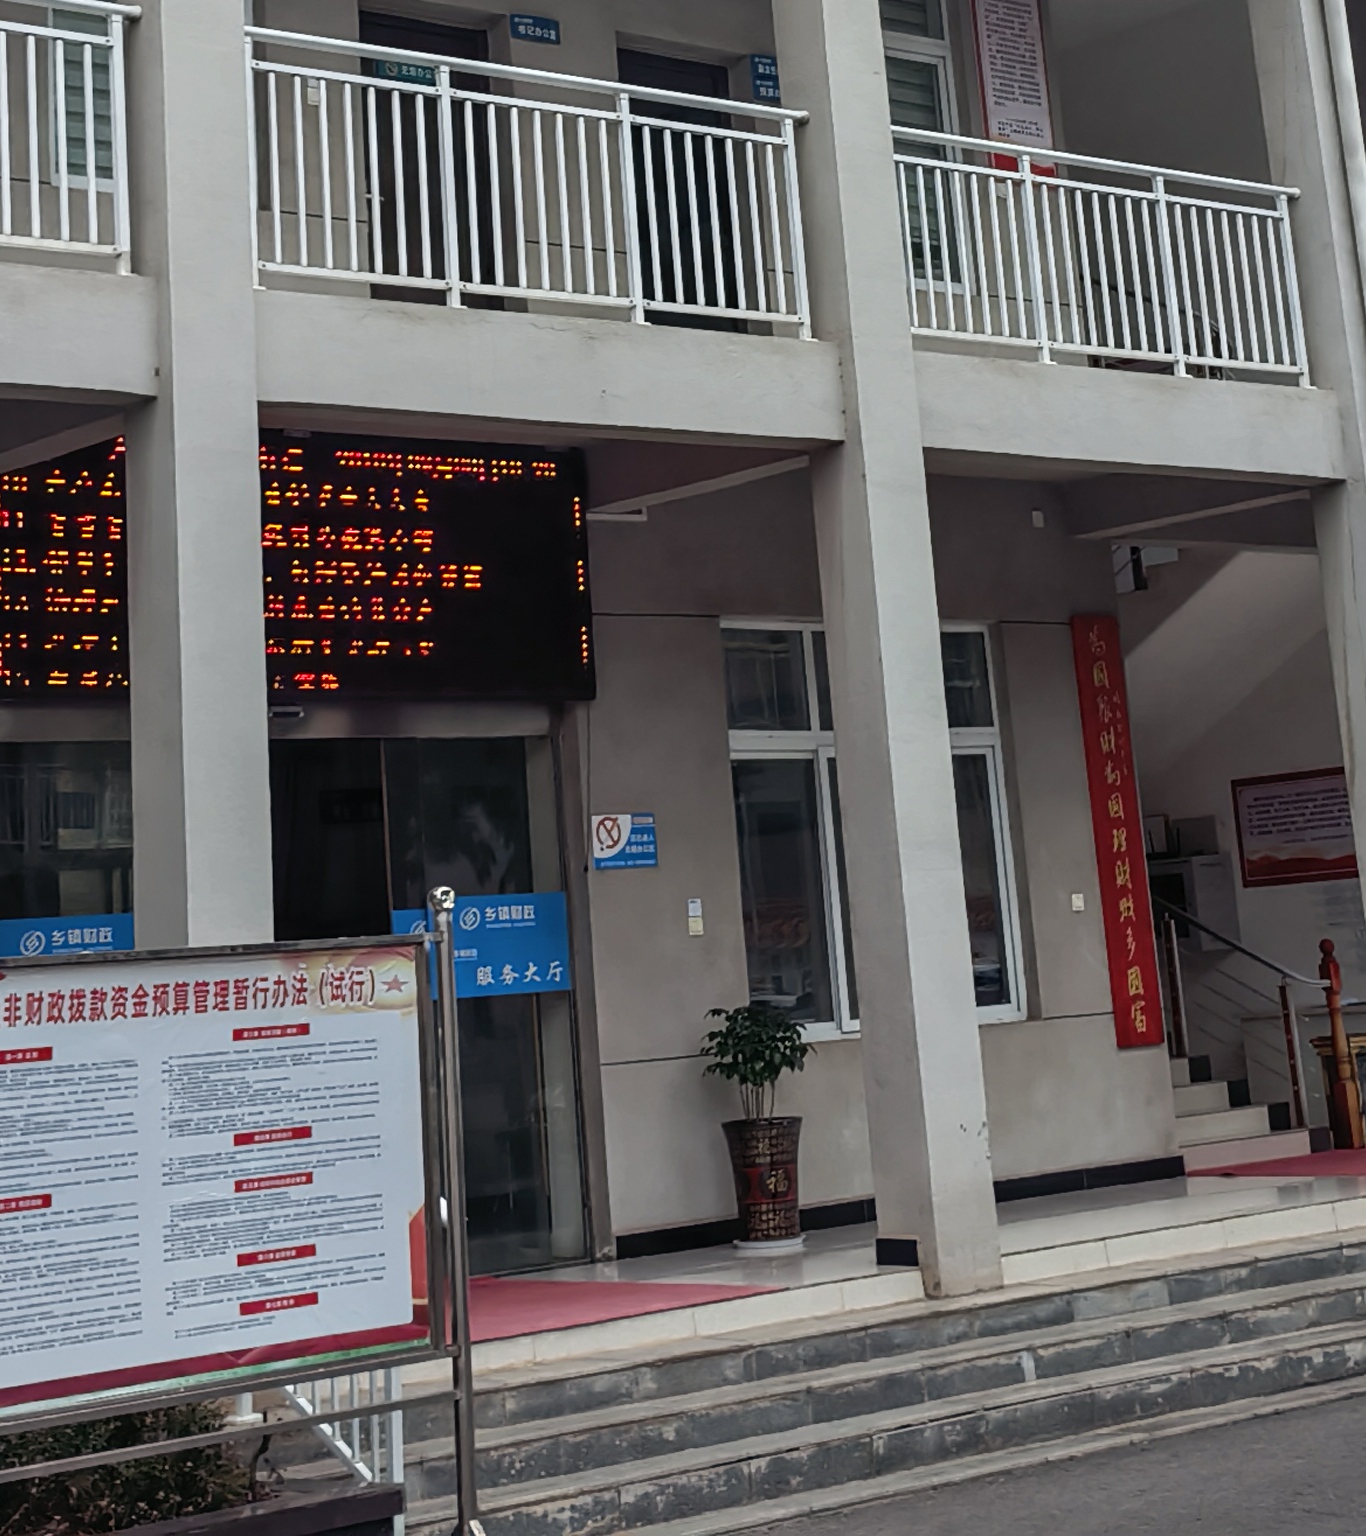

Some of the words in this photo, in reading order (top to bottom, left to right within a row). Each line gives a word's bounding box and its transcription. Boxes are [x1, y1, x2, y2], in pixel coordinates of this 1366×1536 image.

[51, 927, 113, 946] 乡镇财政
[476, 961, 563, 986] 服务大厅
